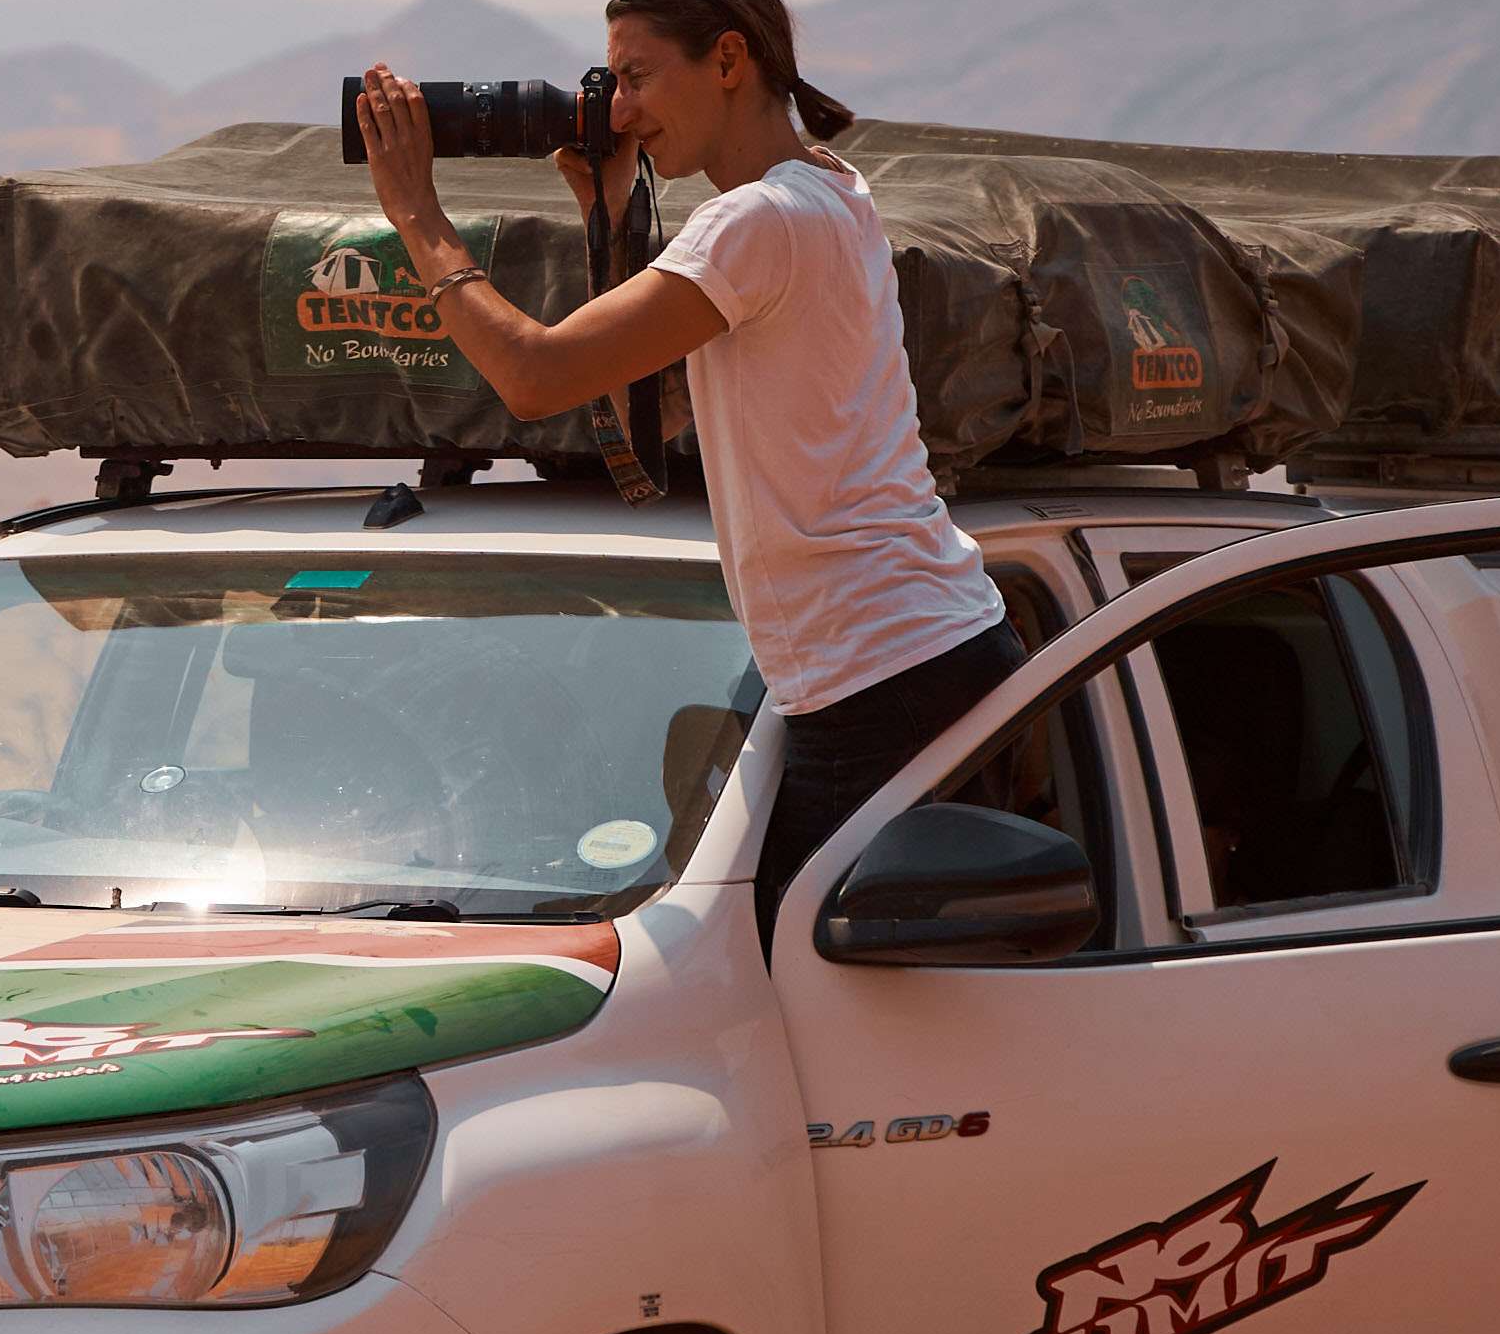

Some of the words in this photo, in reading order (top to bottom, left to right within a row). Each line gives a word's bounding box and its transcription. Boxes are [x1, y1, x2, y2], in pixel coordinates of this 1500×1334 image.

[305, 297, 442, 333] TENTCO
[305, 343, 335, 364] No
[1136, 354, 1198, 382] TENTCO
[1048, 1192, 1247, 1334] NO
